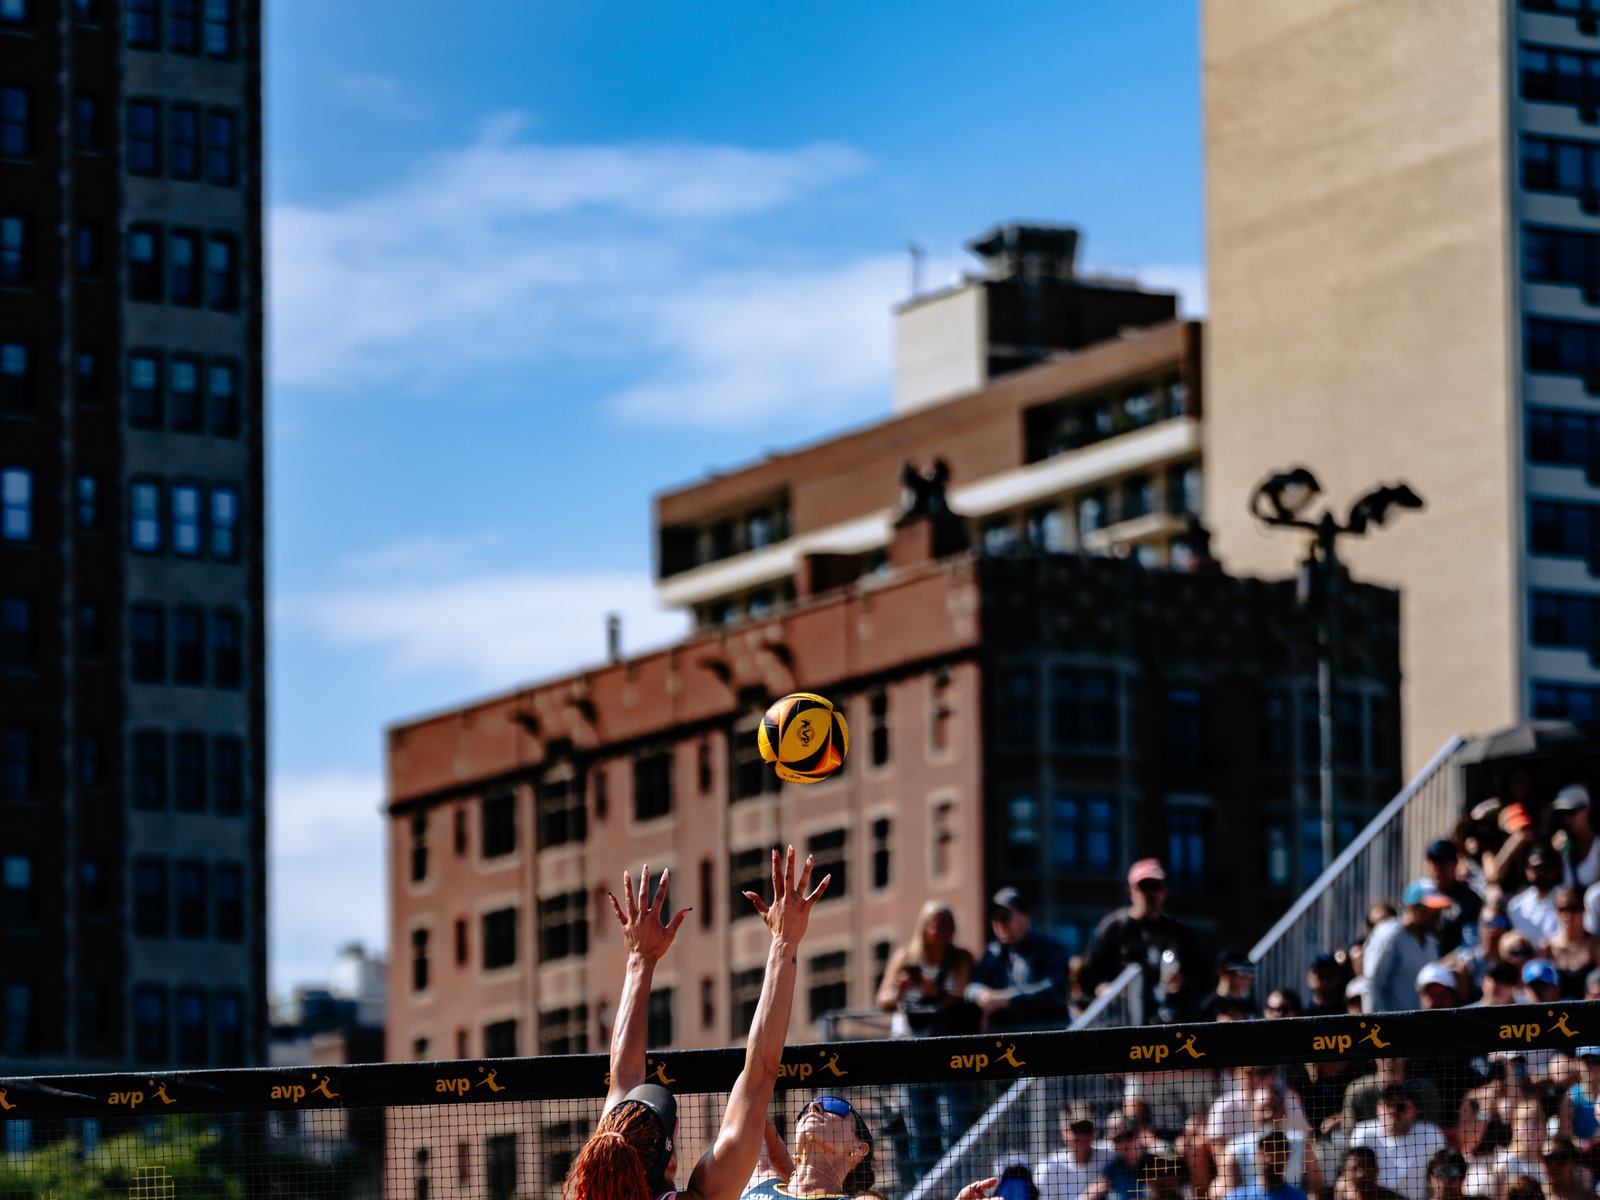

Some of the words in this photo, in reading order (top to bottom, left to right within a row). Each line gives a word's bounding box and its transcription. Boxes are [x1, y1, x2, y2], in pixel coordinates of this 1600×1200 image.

[1499, 1023, 1541, 1042] avp
[1312, 1034, 1351, 1054] avp
[1129, 1044, 1169, 1063] avp
[777, 1063, 813, 1080] avp
[950, 1054, 989, 1072] avp
[271, 1085, 305, 1102] avp
[435, 1078, 470, 1096] avp
[109, 1092, 144, 1108] avp
